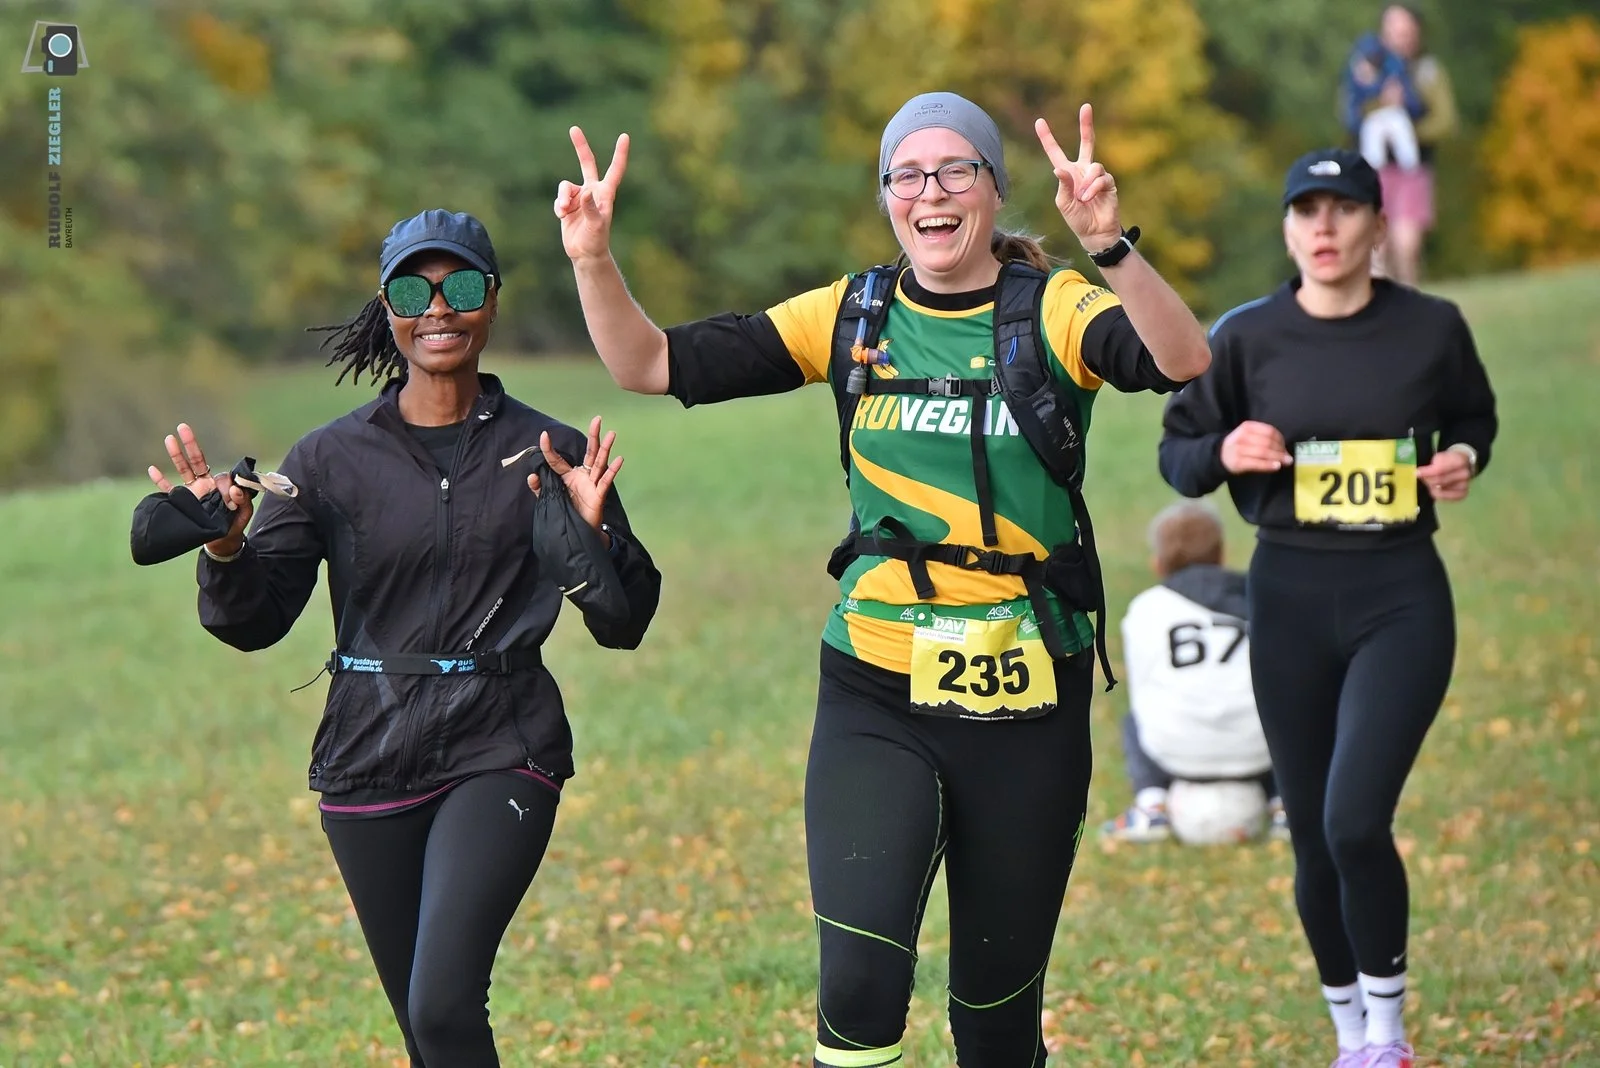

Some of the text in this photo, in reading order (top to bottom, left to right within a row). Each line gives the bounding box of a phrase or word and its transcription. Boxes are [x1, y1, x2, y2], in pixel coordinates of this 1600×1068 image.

[1319, 469, 1396, 506] 205
[474, 597, 503, 639] BROOKS
[934, 617, 966, 634] DAV
[987, 605, 1013, 616] AOK
[1169, 623, 1246, 668] 67
[938, 647, 1030, 697] 235
